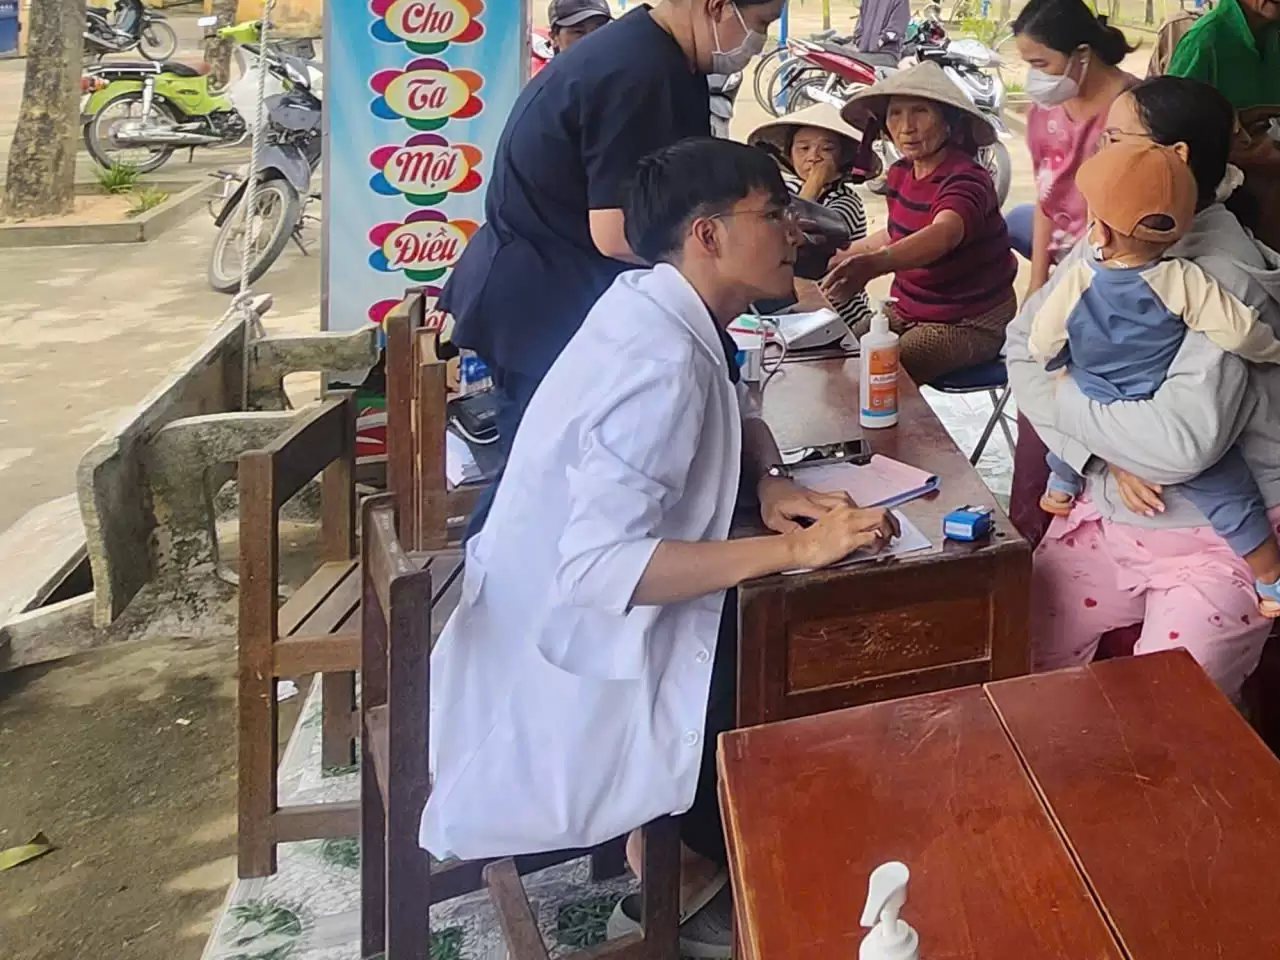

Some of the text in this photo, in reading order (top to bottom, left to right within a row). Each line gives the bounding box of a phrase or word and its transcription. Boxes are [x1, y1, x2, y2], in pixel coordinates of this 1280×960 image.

[402, 3, 454, 34] Cho
[407, 78, 448, 111] Ta
[396, 150, 457, 188] Một
[394, 227, 458, 264] Điều
